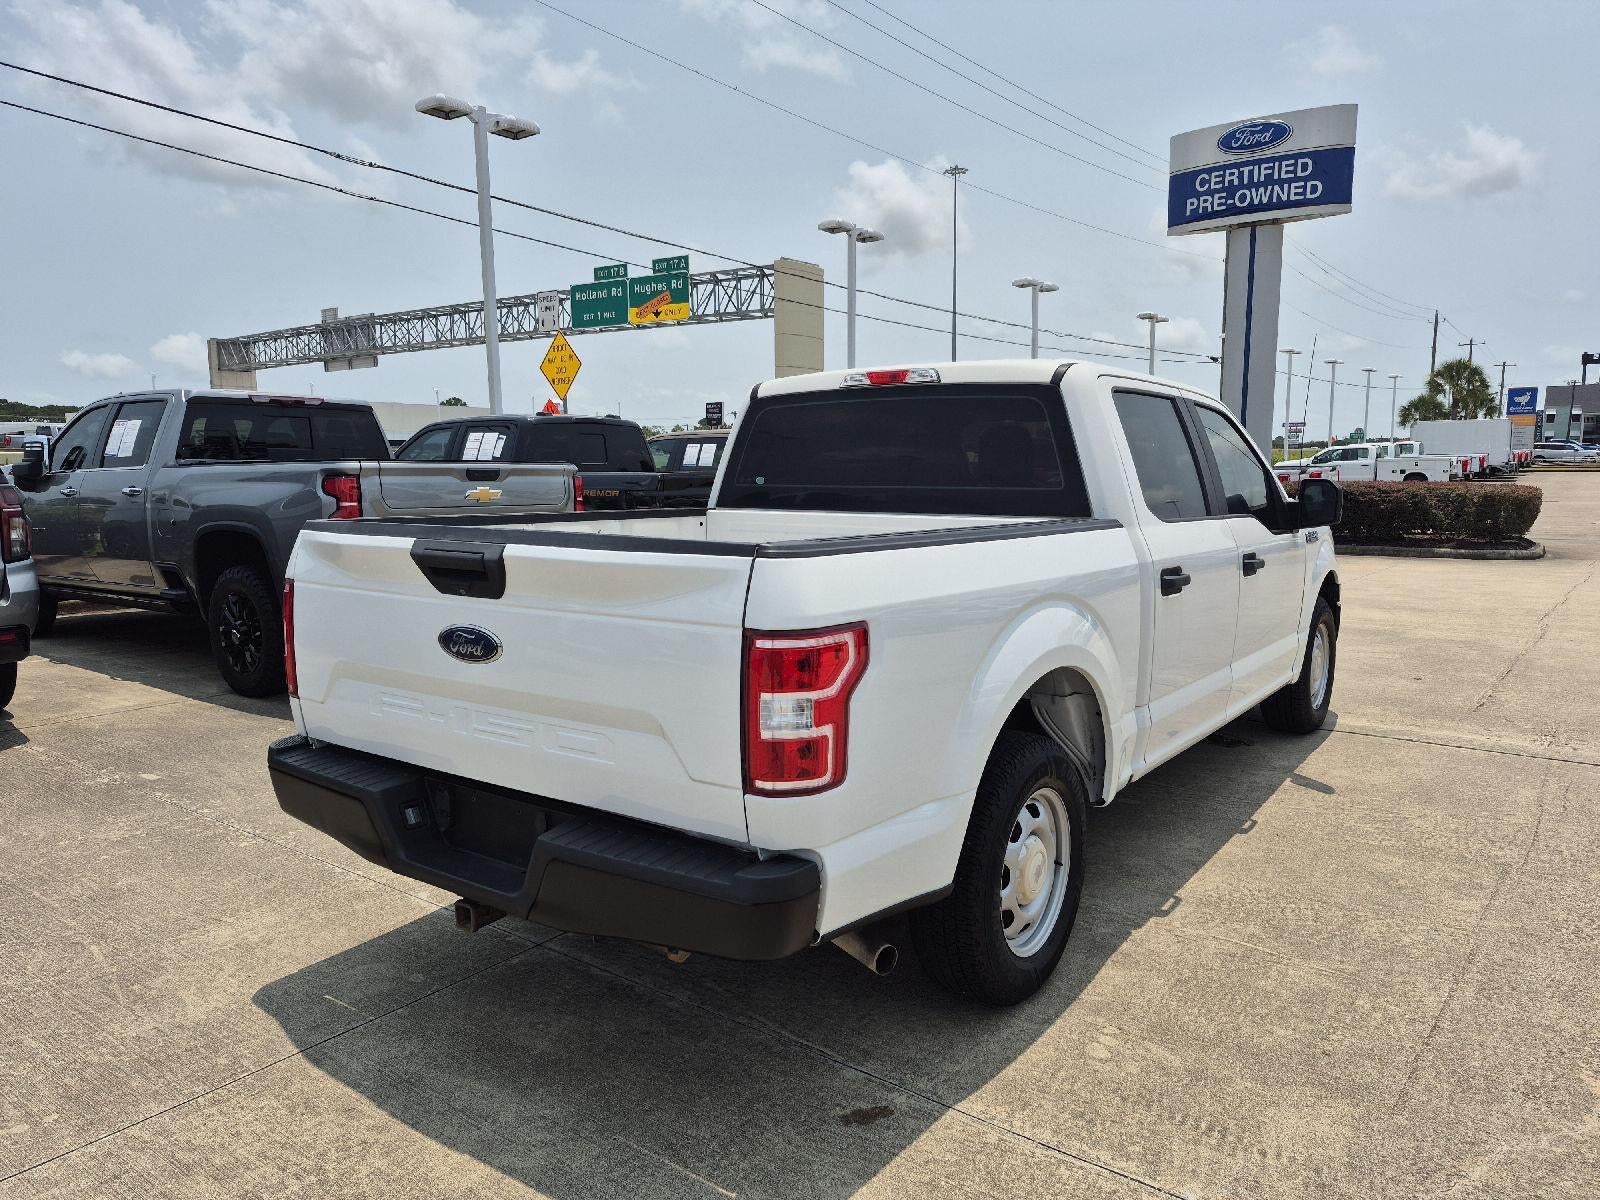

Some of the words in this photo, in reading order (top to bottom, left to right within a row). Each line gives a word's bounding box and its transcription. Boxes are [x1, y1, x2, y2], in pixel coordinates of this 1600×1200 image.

[1231, 126, 1274, 148] Ford
[1195, 158, 1313, 192] CERTIFIED
[1186, 180, 1323, 216] PRE-OWNED
[655, 262, 667, 270] EXIT
[576, 290, 606, 300] Holland
[611, 286, 622, 297] Rd
[634, 282, 667, 294] Hughes
[671, 278, 683, 289] Rd
[650, 294, 669, 309] CLOSED
[664, 308, 682, 316] ONLY
[582, 489, 620, 497] REMOR
[450, 631, 484, 656] Ford
[370, 690, 616, 765] F-150
